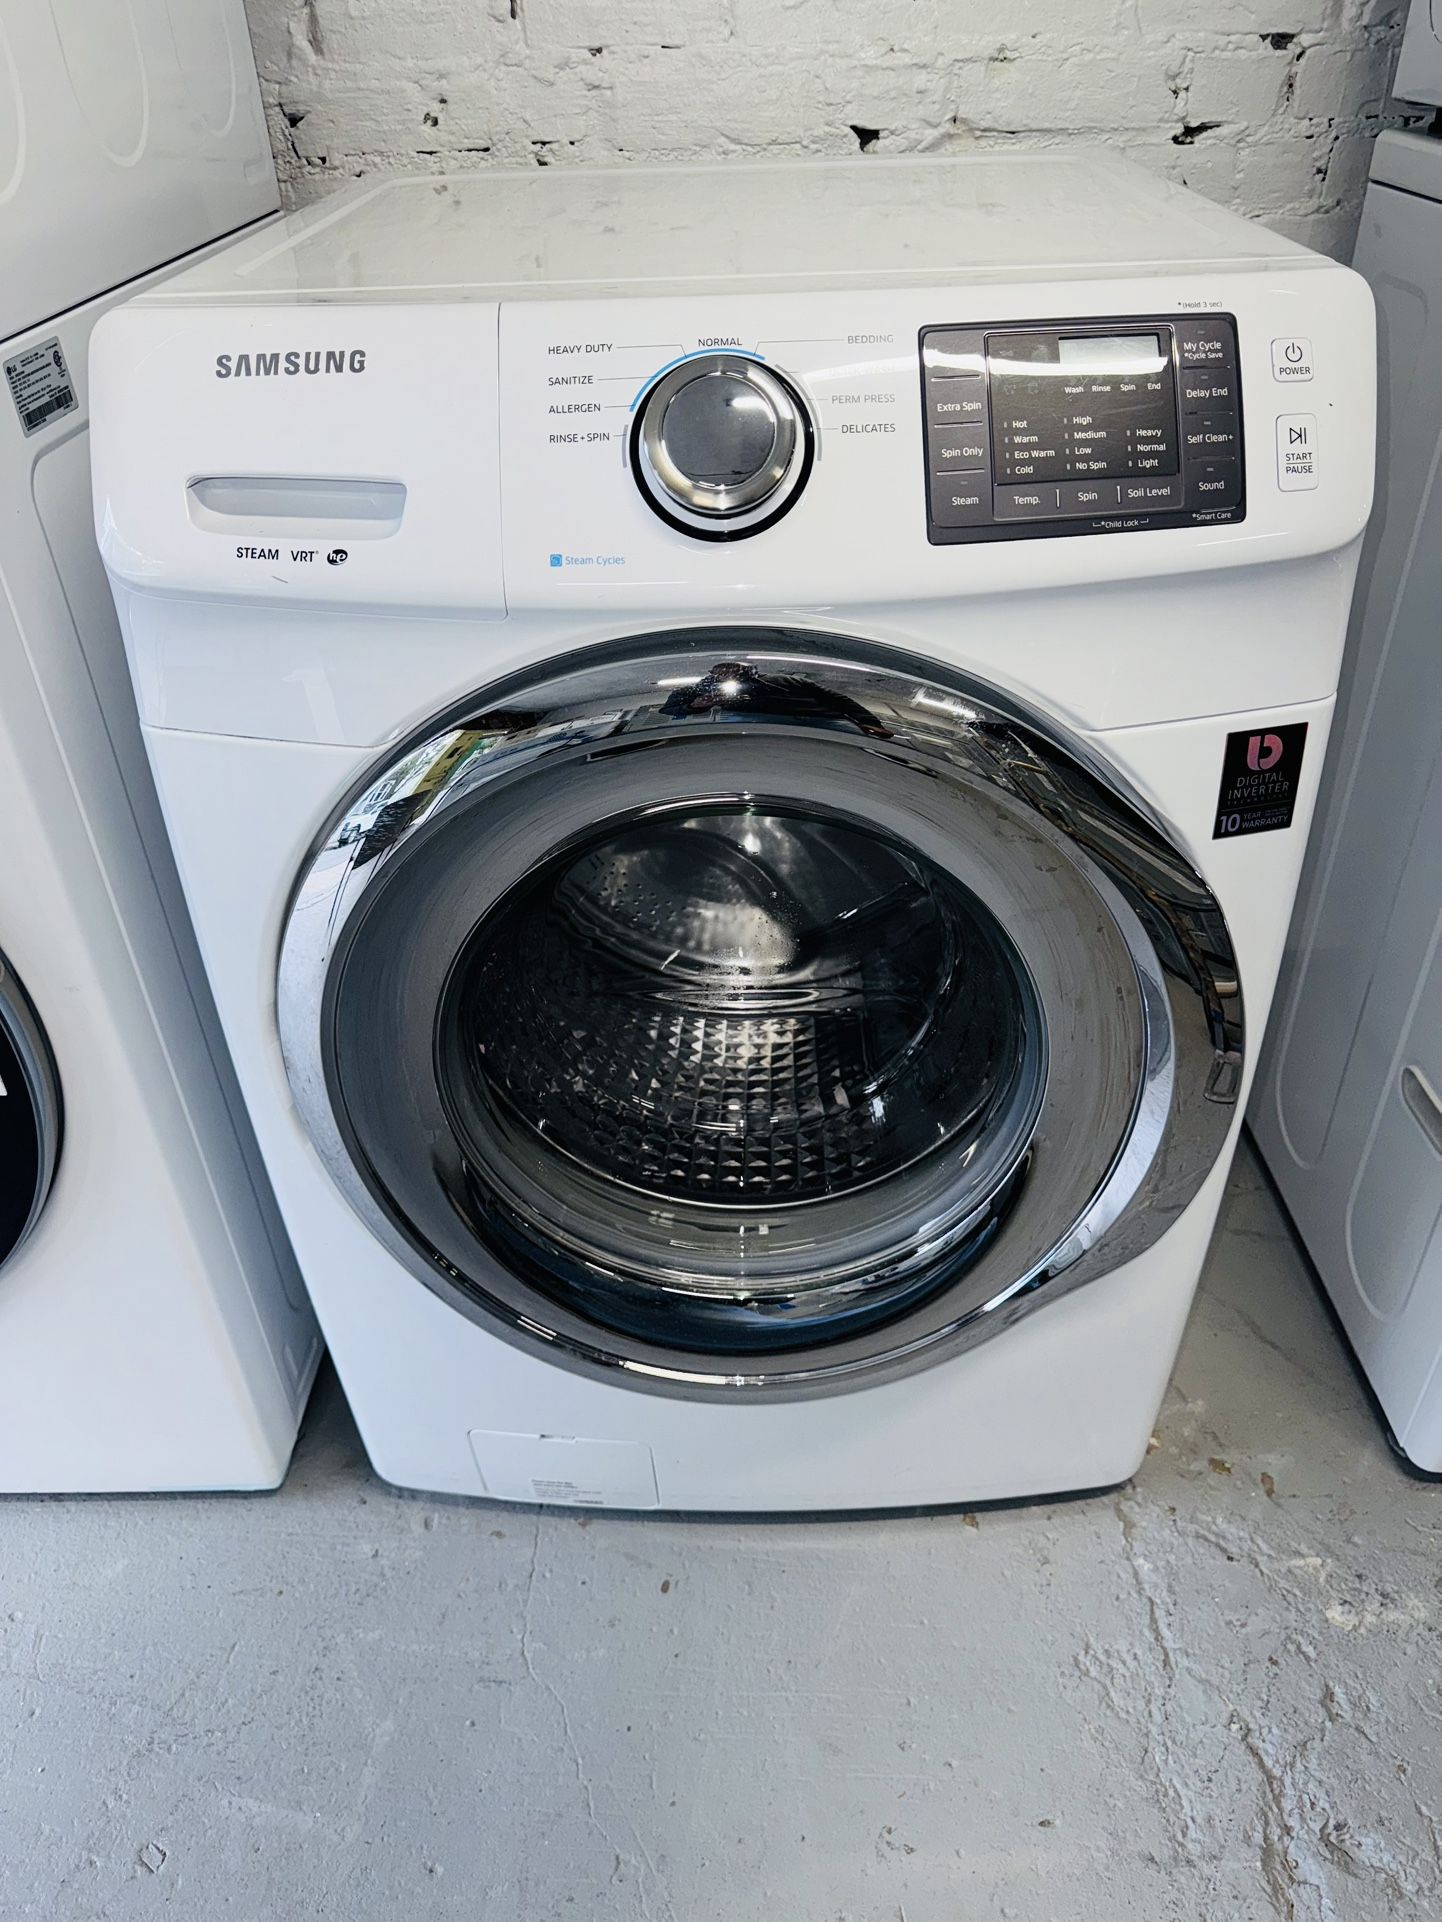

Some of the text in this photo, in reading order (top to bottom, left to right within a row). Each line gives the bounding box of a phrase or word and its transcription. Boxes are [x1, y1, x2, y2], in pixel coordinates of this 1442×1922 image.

[698, 337, 743, 347] NORMAL
[847, 334, 894, 344] BEDDING
[548, 343, 613, 355] HEAVY DUTY
[1183, 341, 1222, 352] My Cycle
[215, 349, 367, 379] SAMSUNG
[1279, 366, 1311, 376] POWER
[548, 375, 594, 386] SANITIZE
[1064, 386, 1084, 394] Wash
[1091, 385, 1111, 393] Rinse
[1120, 383, 1136, 392] Spin
[1186, 387, 1228, 399] Delay End
[831, 393, 896, 404] PERM PRESS
[548, 403, 601, 414] ALLERGEN
[937, 401, 982, 412] Extra Spin
[1012, 420, 1028, 428] Hot
[1073, 416, 1092, 425] High
[841, 423, 896, 434] DELICATES
[1136, 428, 1162, 438] Heavy
[1013, 434, 1038, 443] Warm
[1074, 431, 1107, 439] Medium
[1187, 433, 1204, 444] Self
[941, 446, 984, 459] Spin Only
[1075, 447, 1092, 455] Low
[1137, 443, 1166, 452] Normal
[1014, 449, 1056, 459] Eco Warm
[1285, 452, 1313, 462] START
[1076, 460, 1107, 470] No Spin
[1138, 459, 1159, 468] Light
[1015, 465, 1034, 475] Cold
[1285, 465, 1313, 475] PAUSE
[1198, 480, 1225, 491] Sound
[1077, 491, 1098, 502] Spin
[1127, 486, 1171, 498] Soil Level
[951, 496, 979, 506] Steam
[1013, 495, 1041, 505] Temp.
[1123, 519, 1139, 527] Lock
[236, 546, 279, 561] STEAM
[565, 555, 626, 566] Steam Cycles
[1236, 772, 1284, 788] DIGITAL
[1228, 781, 1289, 800] INVERTER
[1243, 811, 1261, 819] YEAR
[1220, 813, 1241, 833] 10
[1241, 815, 1289, 829] WARRANTY
